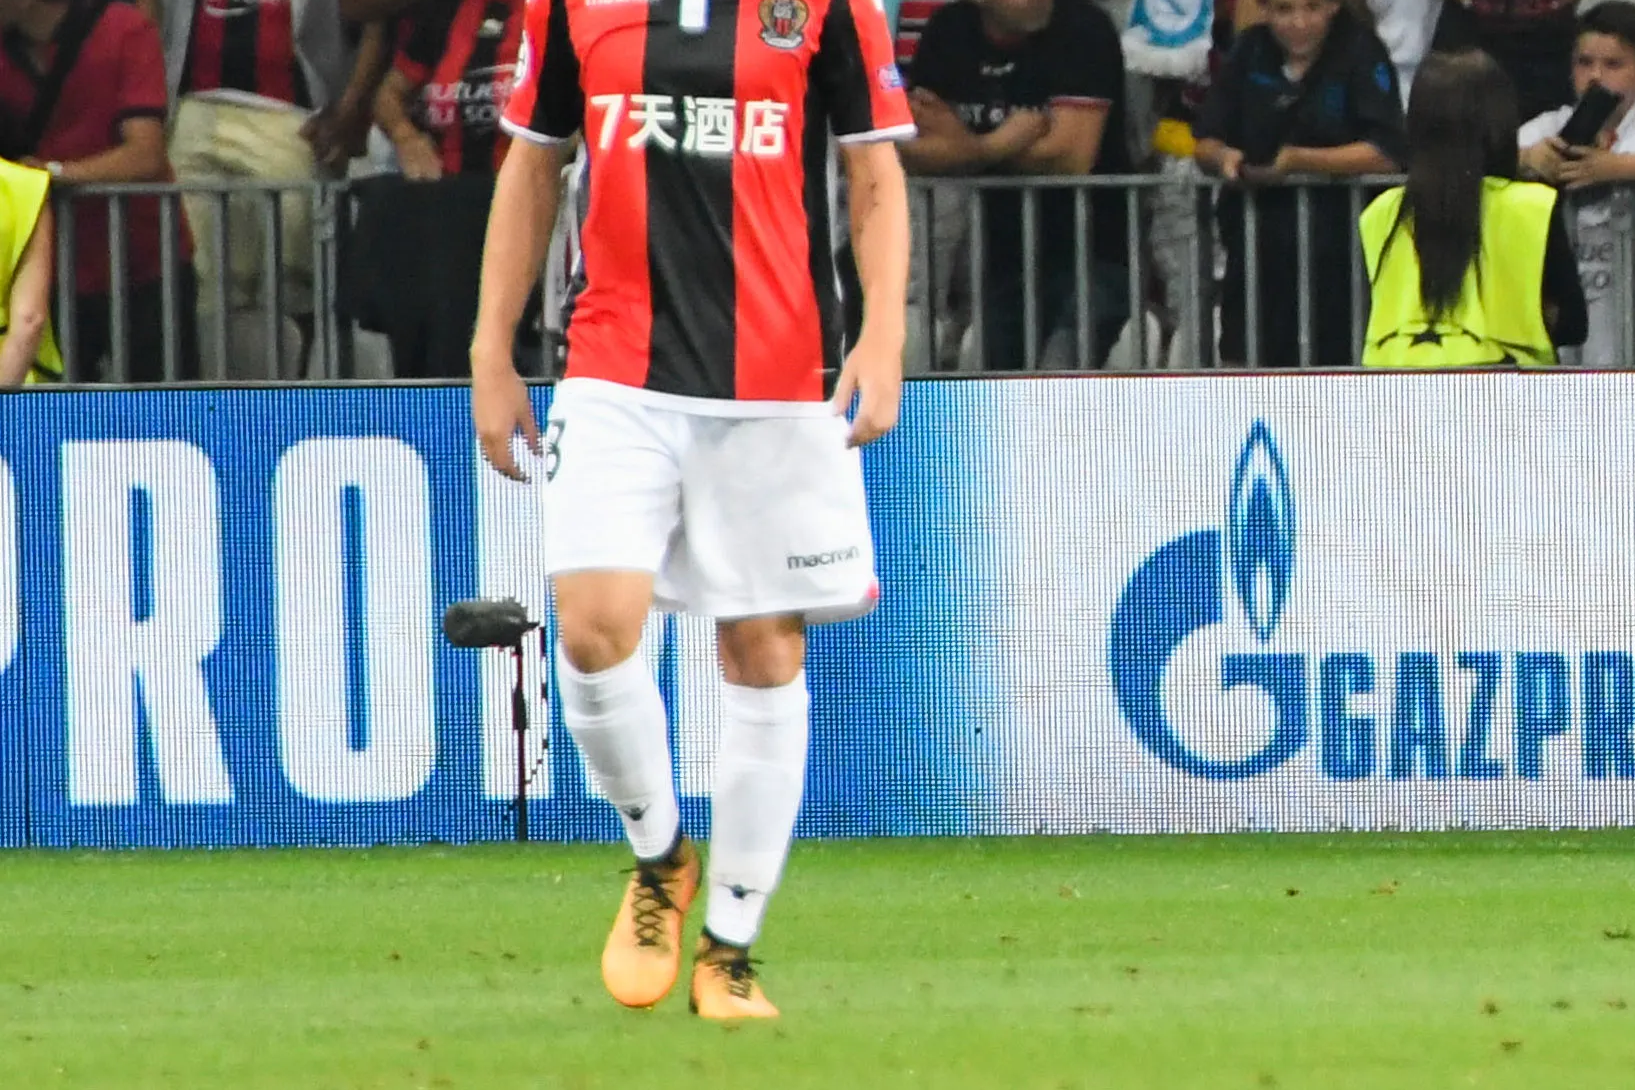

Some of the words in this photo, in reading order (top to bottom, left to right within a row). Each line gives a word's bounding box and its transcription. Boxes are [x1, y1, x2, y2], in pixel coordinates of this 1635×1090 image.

[591, 93, 789, 155] 7天酒店
[788, 547, 860, 570] macron
